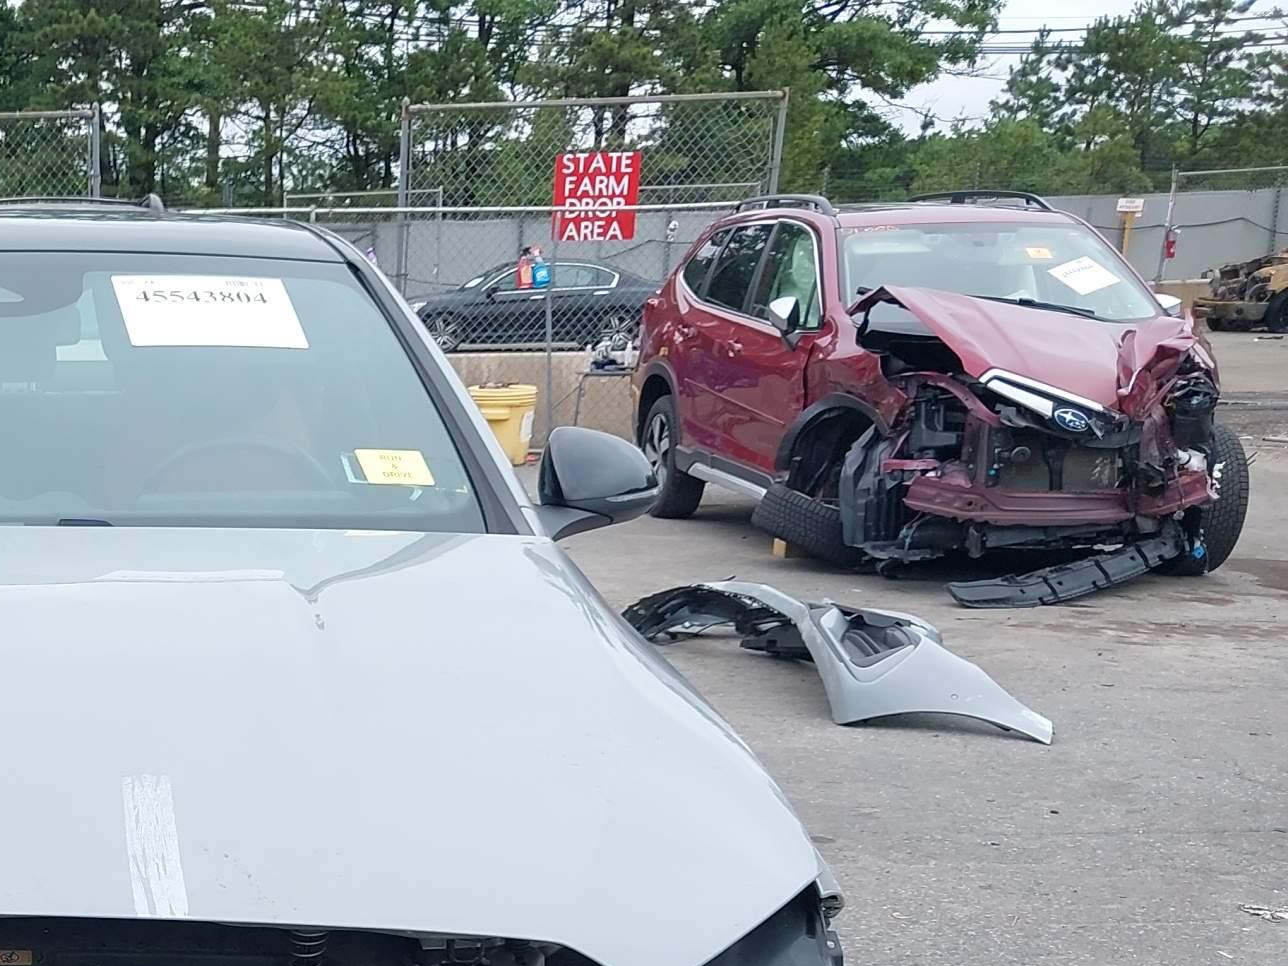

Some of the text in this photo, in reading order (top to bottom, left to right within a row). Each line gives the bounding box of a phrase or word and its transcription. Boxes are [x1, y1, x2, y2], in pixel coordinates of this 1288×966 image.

[562, 152, 634, 174] STATE
[564, 175, 629, 197] FARM
[564, 198, 626, 218] DROP
[562, 221, 623, 241] AREA
[136, 290, 268, 303] 45543804
